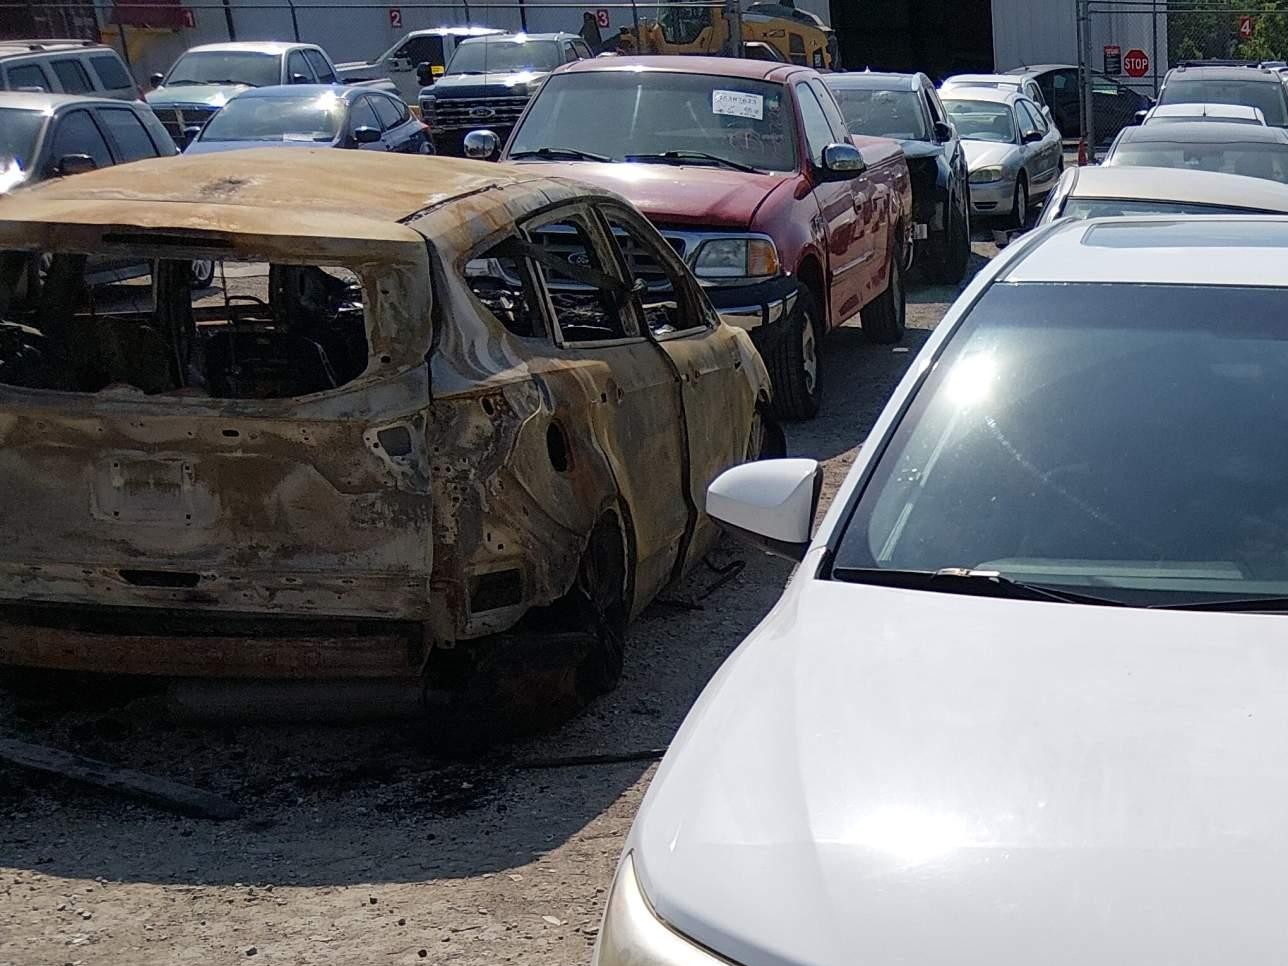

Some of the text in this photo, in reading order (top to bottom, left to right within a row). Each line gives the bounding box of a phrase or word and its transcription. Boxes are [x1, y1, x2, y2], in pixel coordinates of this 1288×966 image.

[391, 12, 401, 26] 2
[597, 11, 608, 26] 3
[1240, 20, 1251, 35] 4
[1124, 58, 1148, 70] STOP
